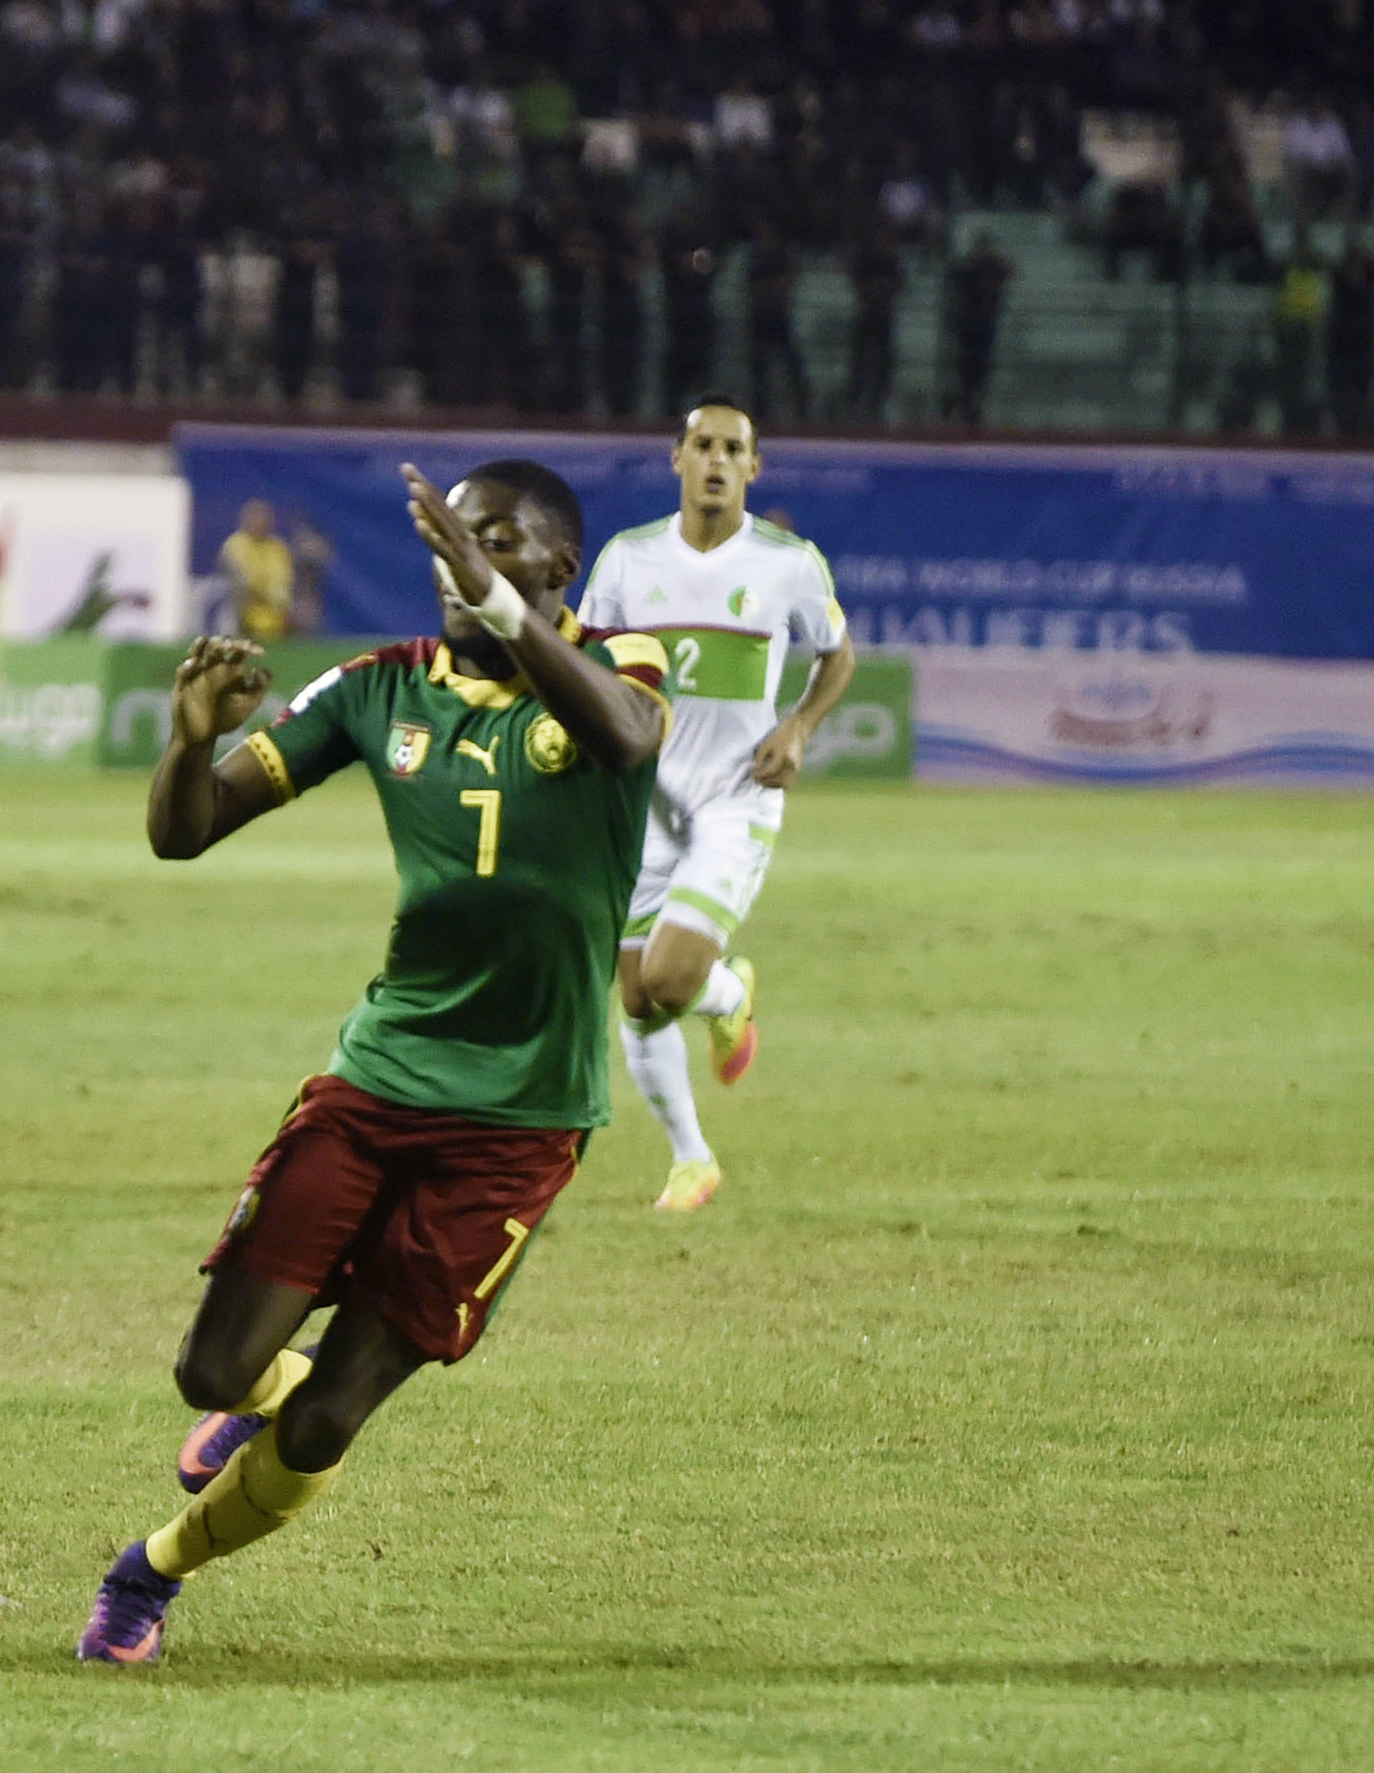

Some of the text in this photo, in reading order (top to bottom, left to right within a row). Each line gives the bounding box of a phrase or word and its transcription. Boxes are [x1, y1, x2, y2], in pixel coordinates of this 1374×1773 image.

[676, 637, 701, 690] 2
[459, 789, 502, 877] 7
[473, 1217, 529, 1299] 7
